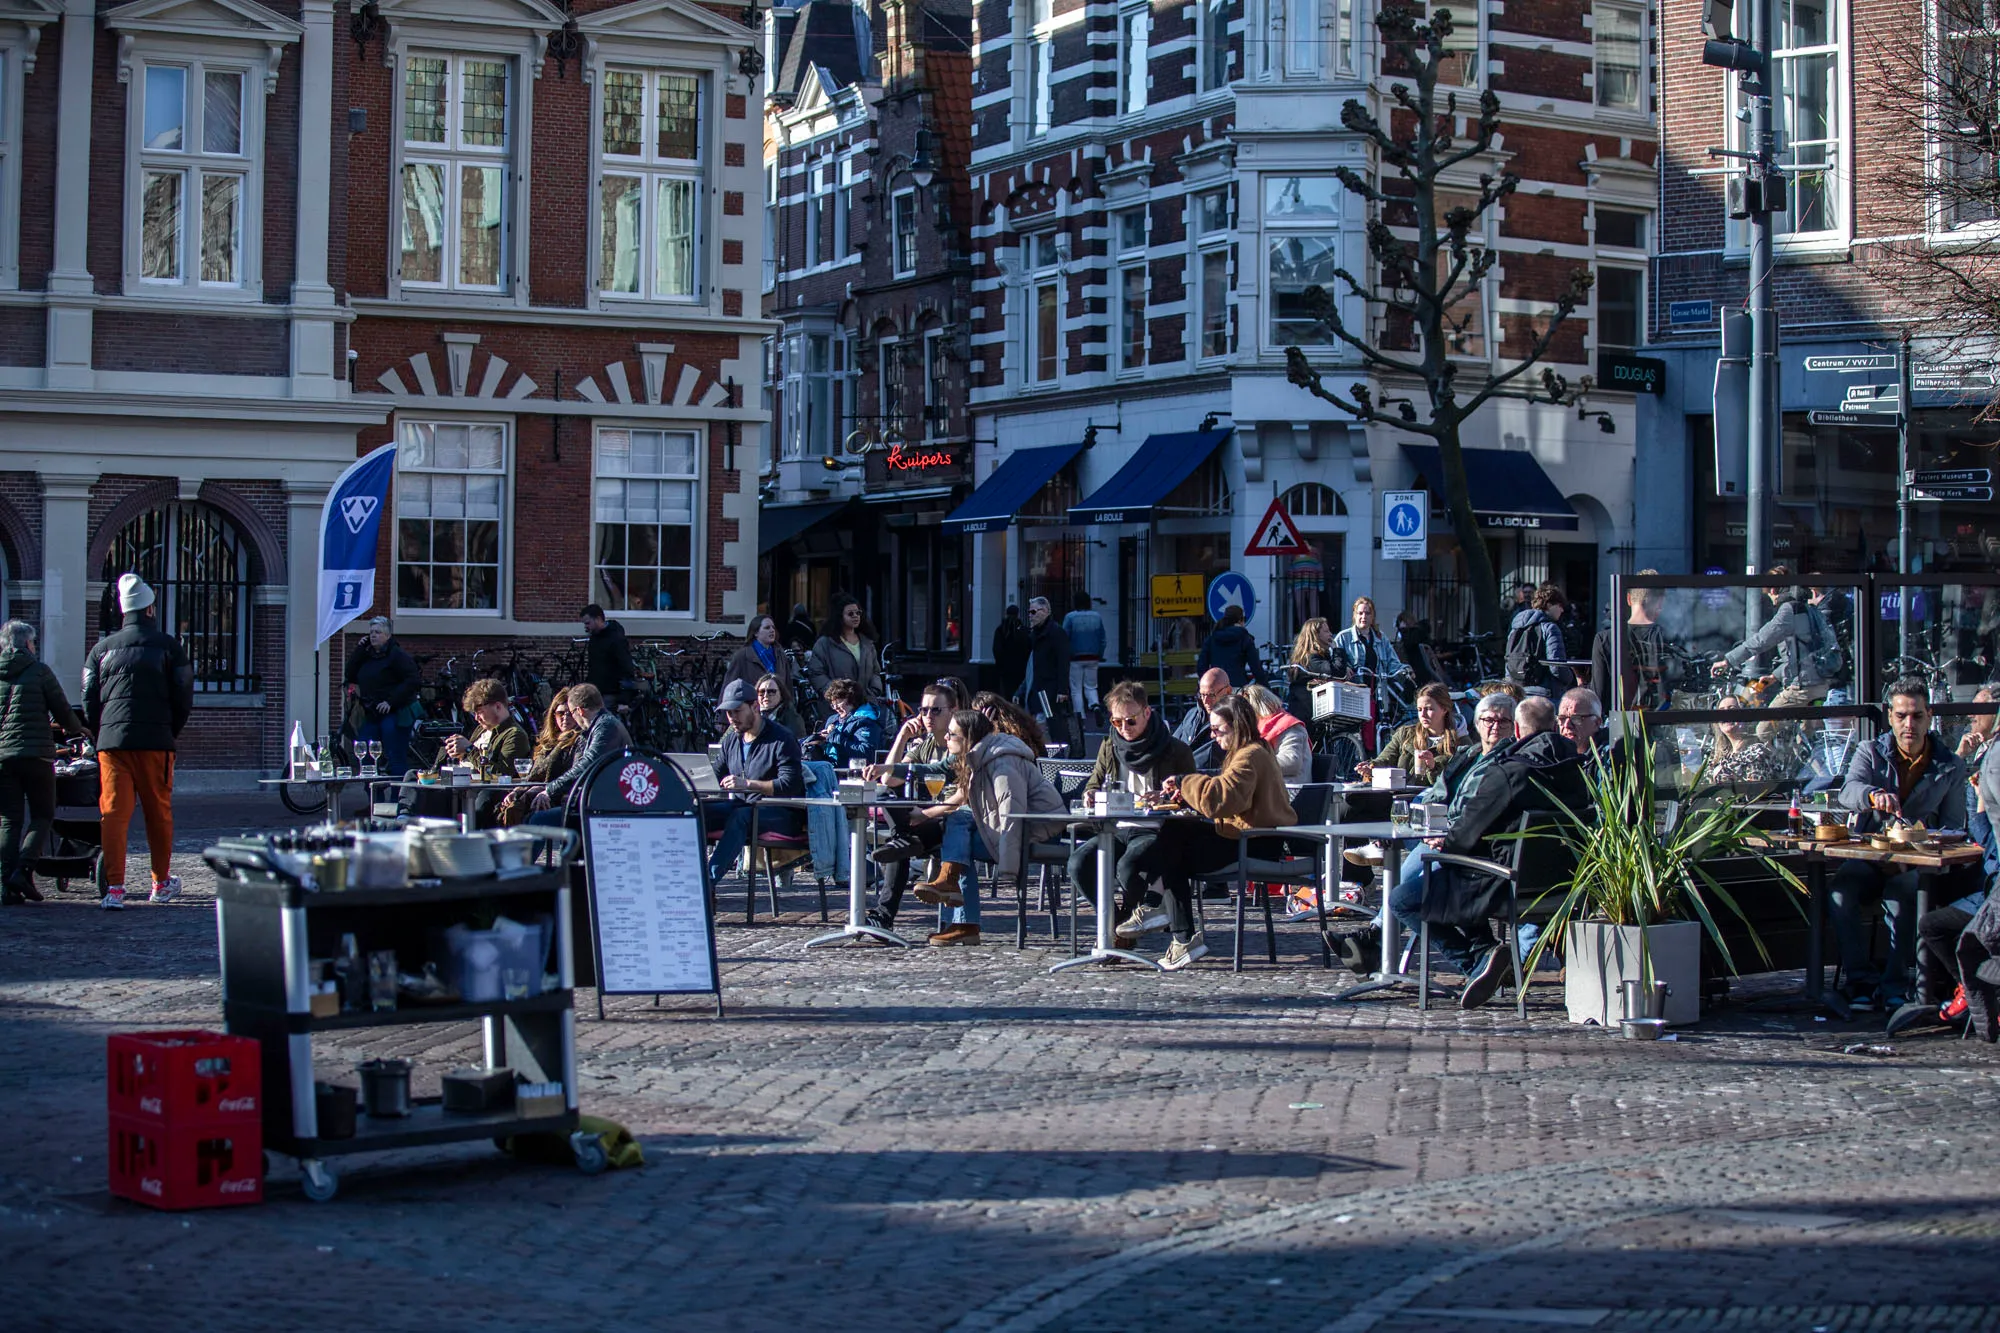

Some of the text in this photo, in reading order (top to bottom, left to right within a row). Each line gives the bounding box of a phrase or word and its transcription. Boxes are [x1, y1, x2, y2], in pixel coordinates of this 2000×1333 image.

[1690, 306, 1709, 316] Markt
[1614, 365, 1656, 382] DOUGLAS
[1845, 403, 1870, 411] Patronaat
[1817, 414, 1858, 422] Bibliotheek
[887, 444, 952, 470] Kuipers
[1095, 512, 1124, 522] LA BOULE
[963, 522, 988, 532] LA BOULE
[1488, 517, 1541, 528] LA BOULE
[620, 762, 654, 785] JOPEN
[626, 783, 659, 806] JOPEN
